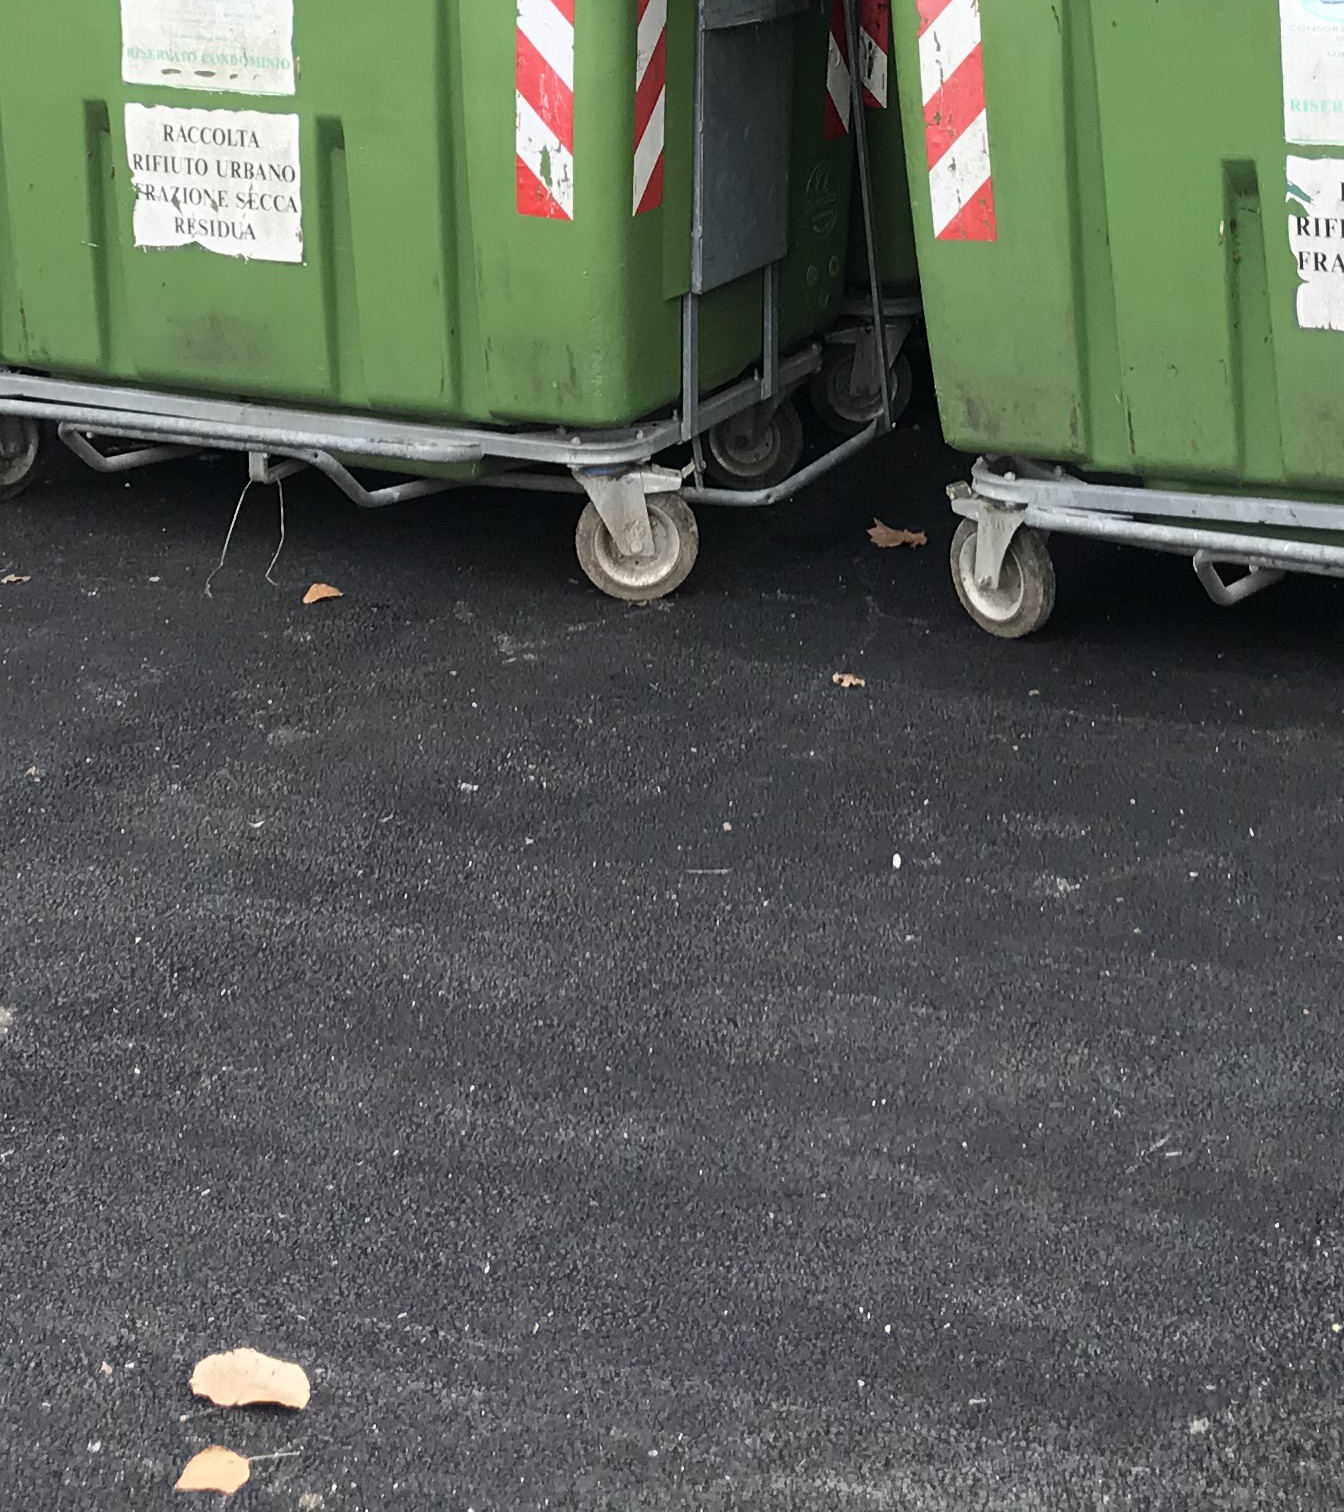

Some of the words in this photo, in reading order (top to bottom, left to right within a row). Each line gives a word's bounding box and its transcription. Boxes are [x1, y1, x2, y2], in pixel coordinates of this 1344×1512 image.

[163, 124, 259, 148] RACCOLTA
[133, 154, 208, 176] RIFIUTO
[216, 160, 295, 183] URBANO
[135, 182, 228, 208] FRAZIONE
[236, 192, 297, 213] SECCA
[174, 217, 256, 240] RESIDUA
